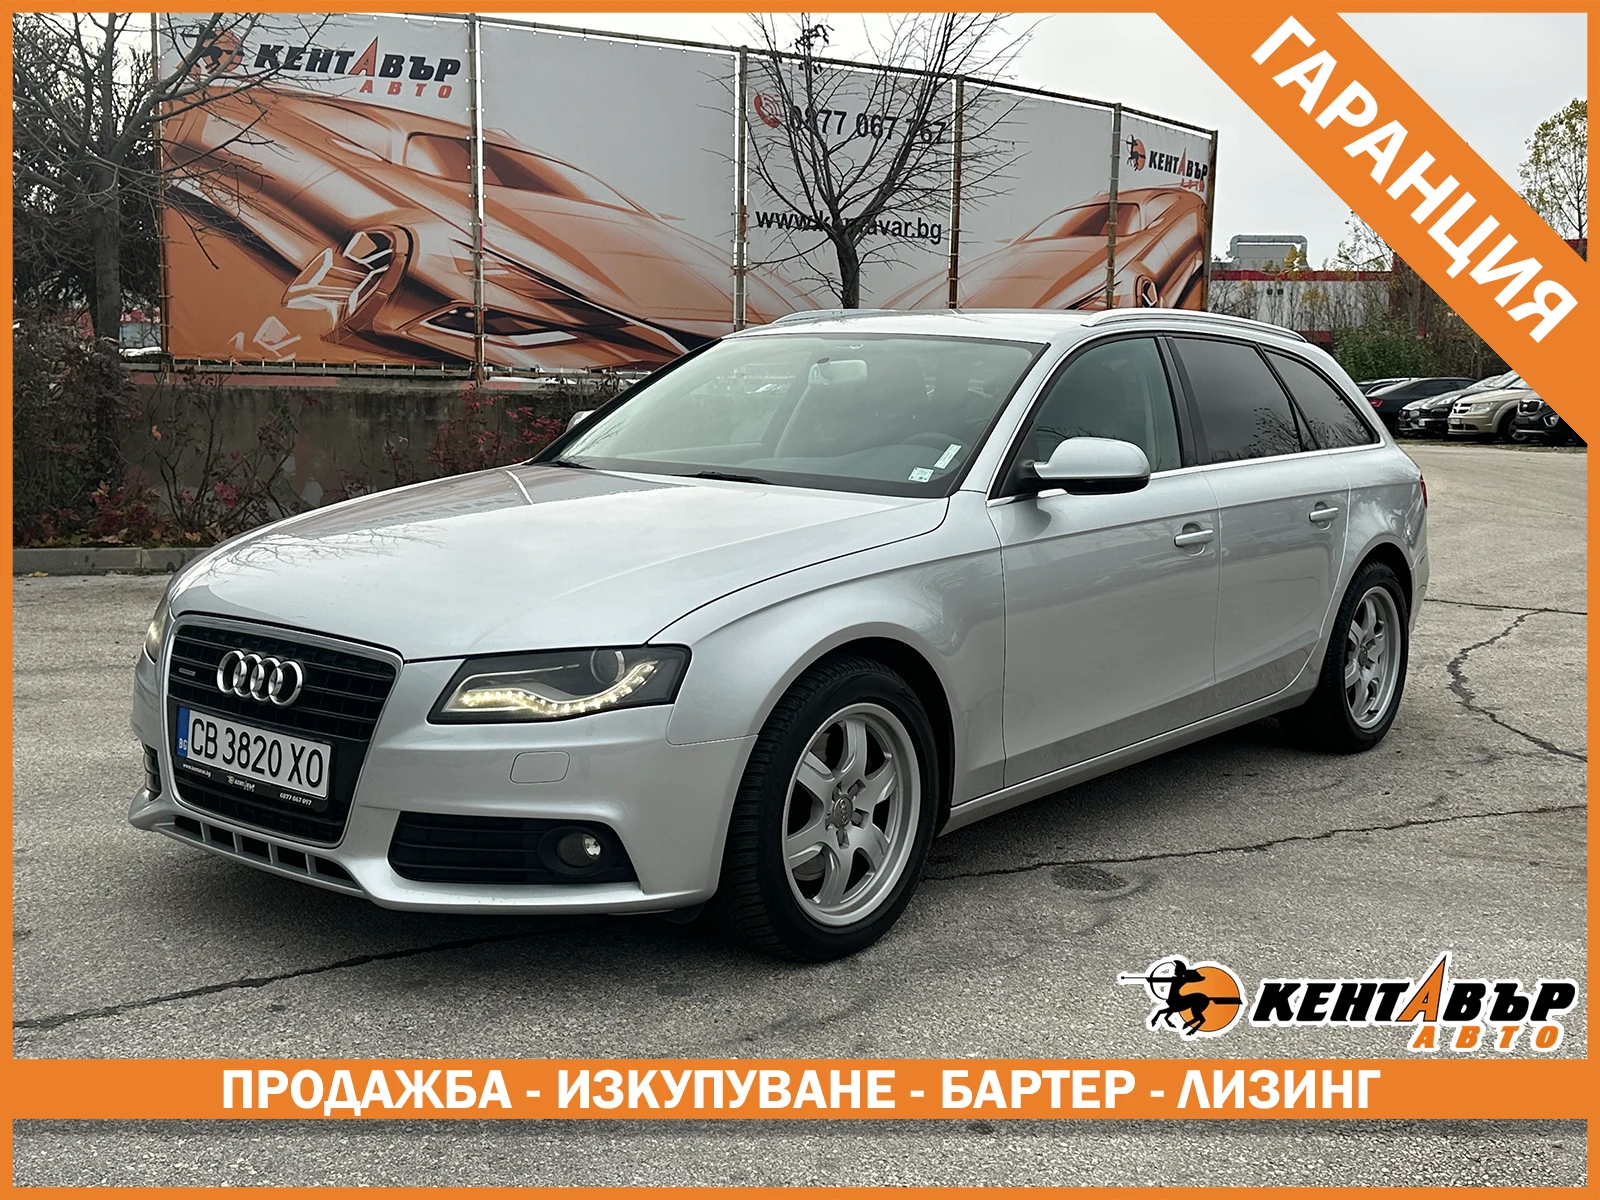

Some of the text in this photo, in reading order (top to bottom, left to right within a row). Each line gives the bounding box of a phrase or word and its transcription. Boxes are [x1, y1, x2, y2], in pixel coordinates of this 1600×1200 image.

[253, 36, 461, 82] КЕНТАВЪР
[359, 80, 453, 99] АВТО
[856, 113, 897, 140] 067
[1148, 147, 1209, 181] КЕНТАВЪР
[755, 210, 942, 245] www.kavar.bg
[178, 737, 188, 750] BG
[191, 718, 323, 788] CB 3820 XO
